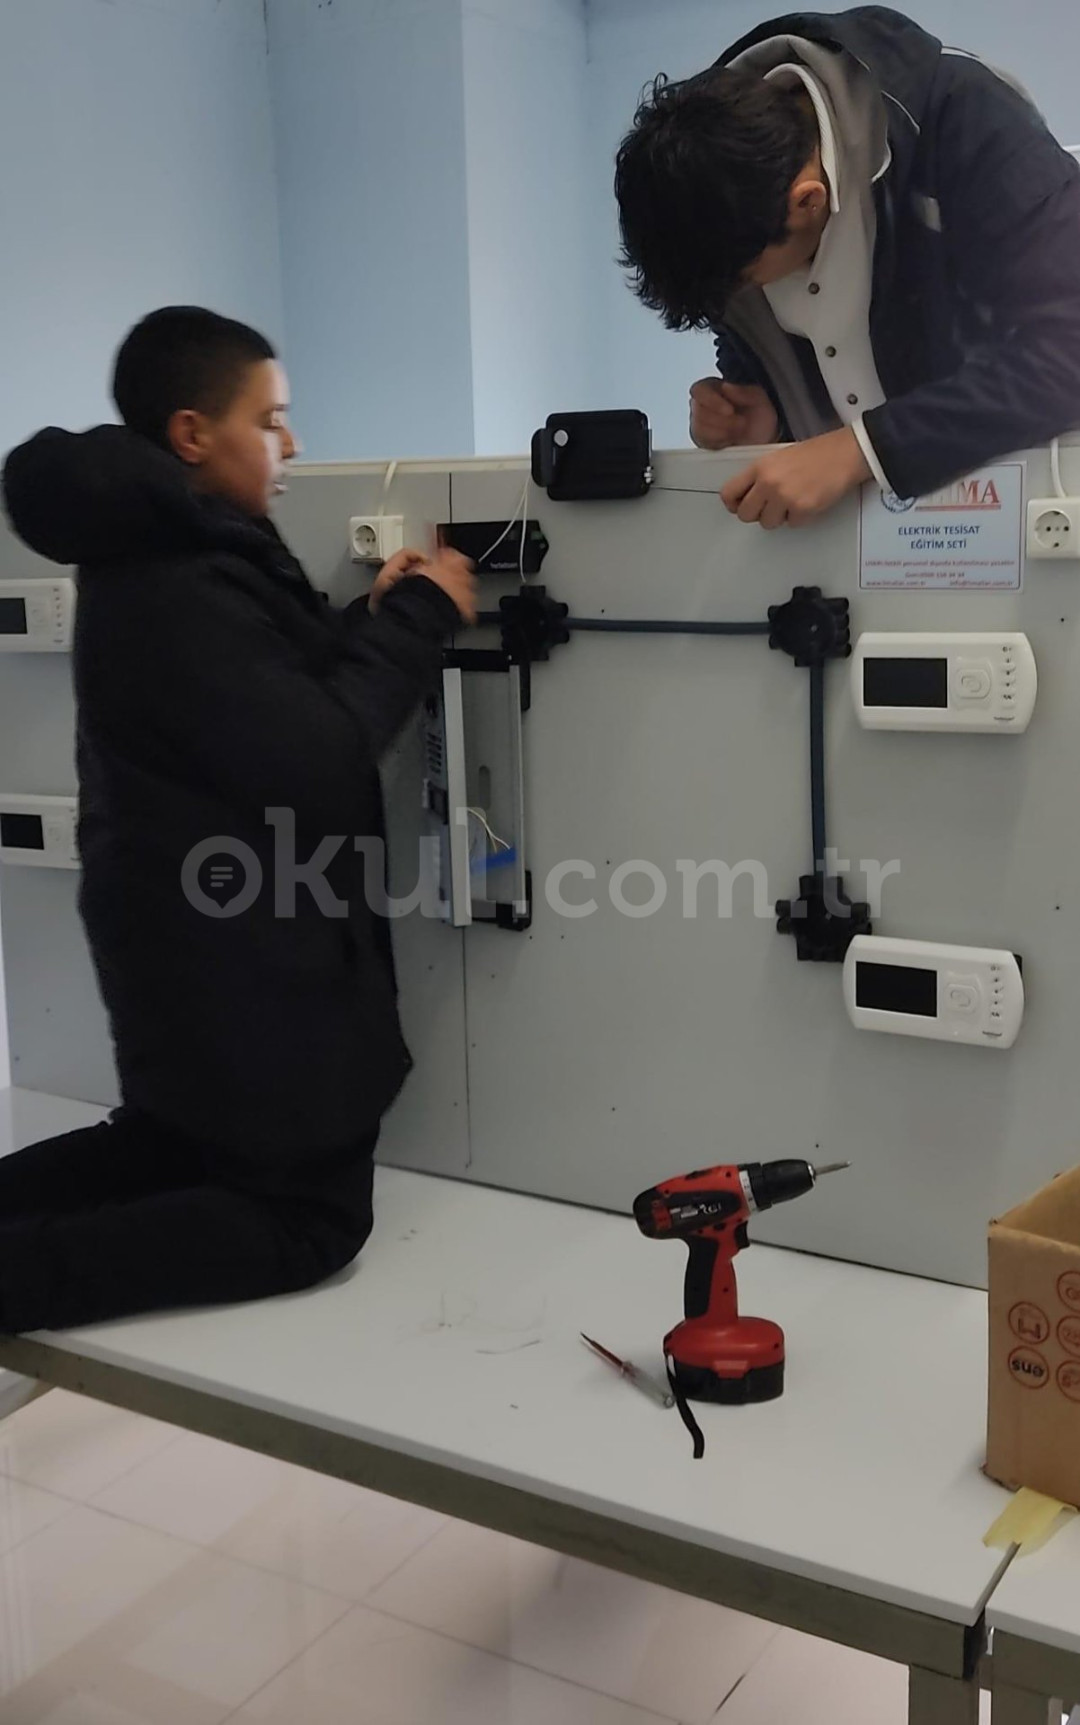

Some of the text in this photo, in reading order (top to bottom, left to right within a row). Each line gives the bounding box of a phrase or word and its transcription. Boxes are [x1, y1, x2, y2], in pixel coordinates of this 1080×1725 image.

[898, 524, 980, 536] ELEKTRİK TESİSAT
[910, 537, 967, 550] EĞİTİM SETİ
